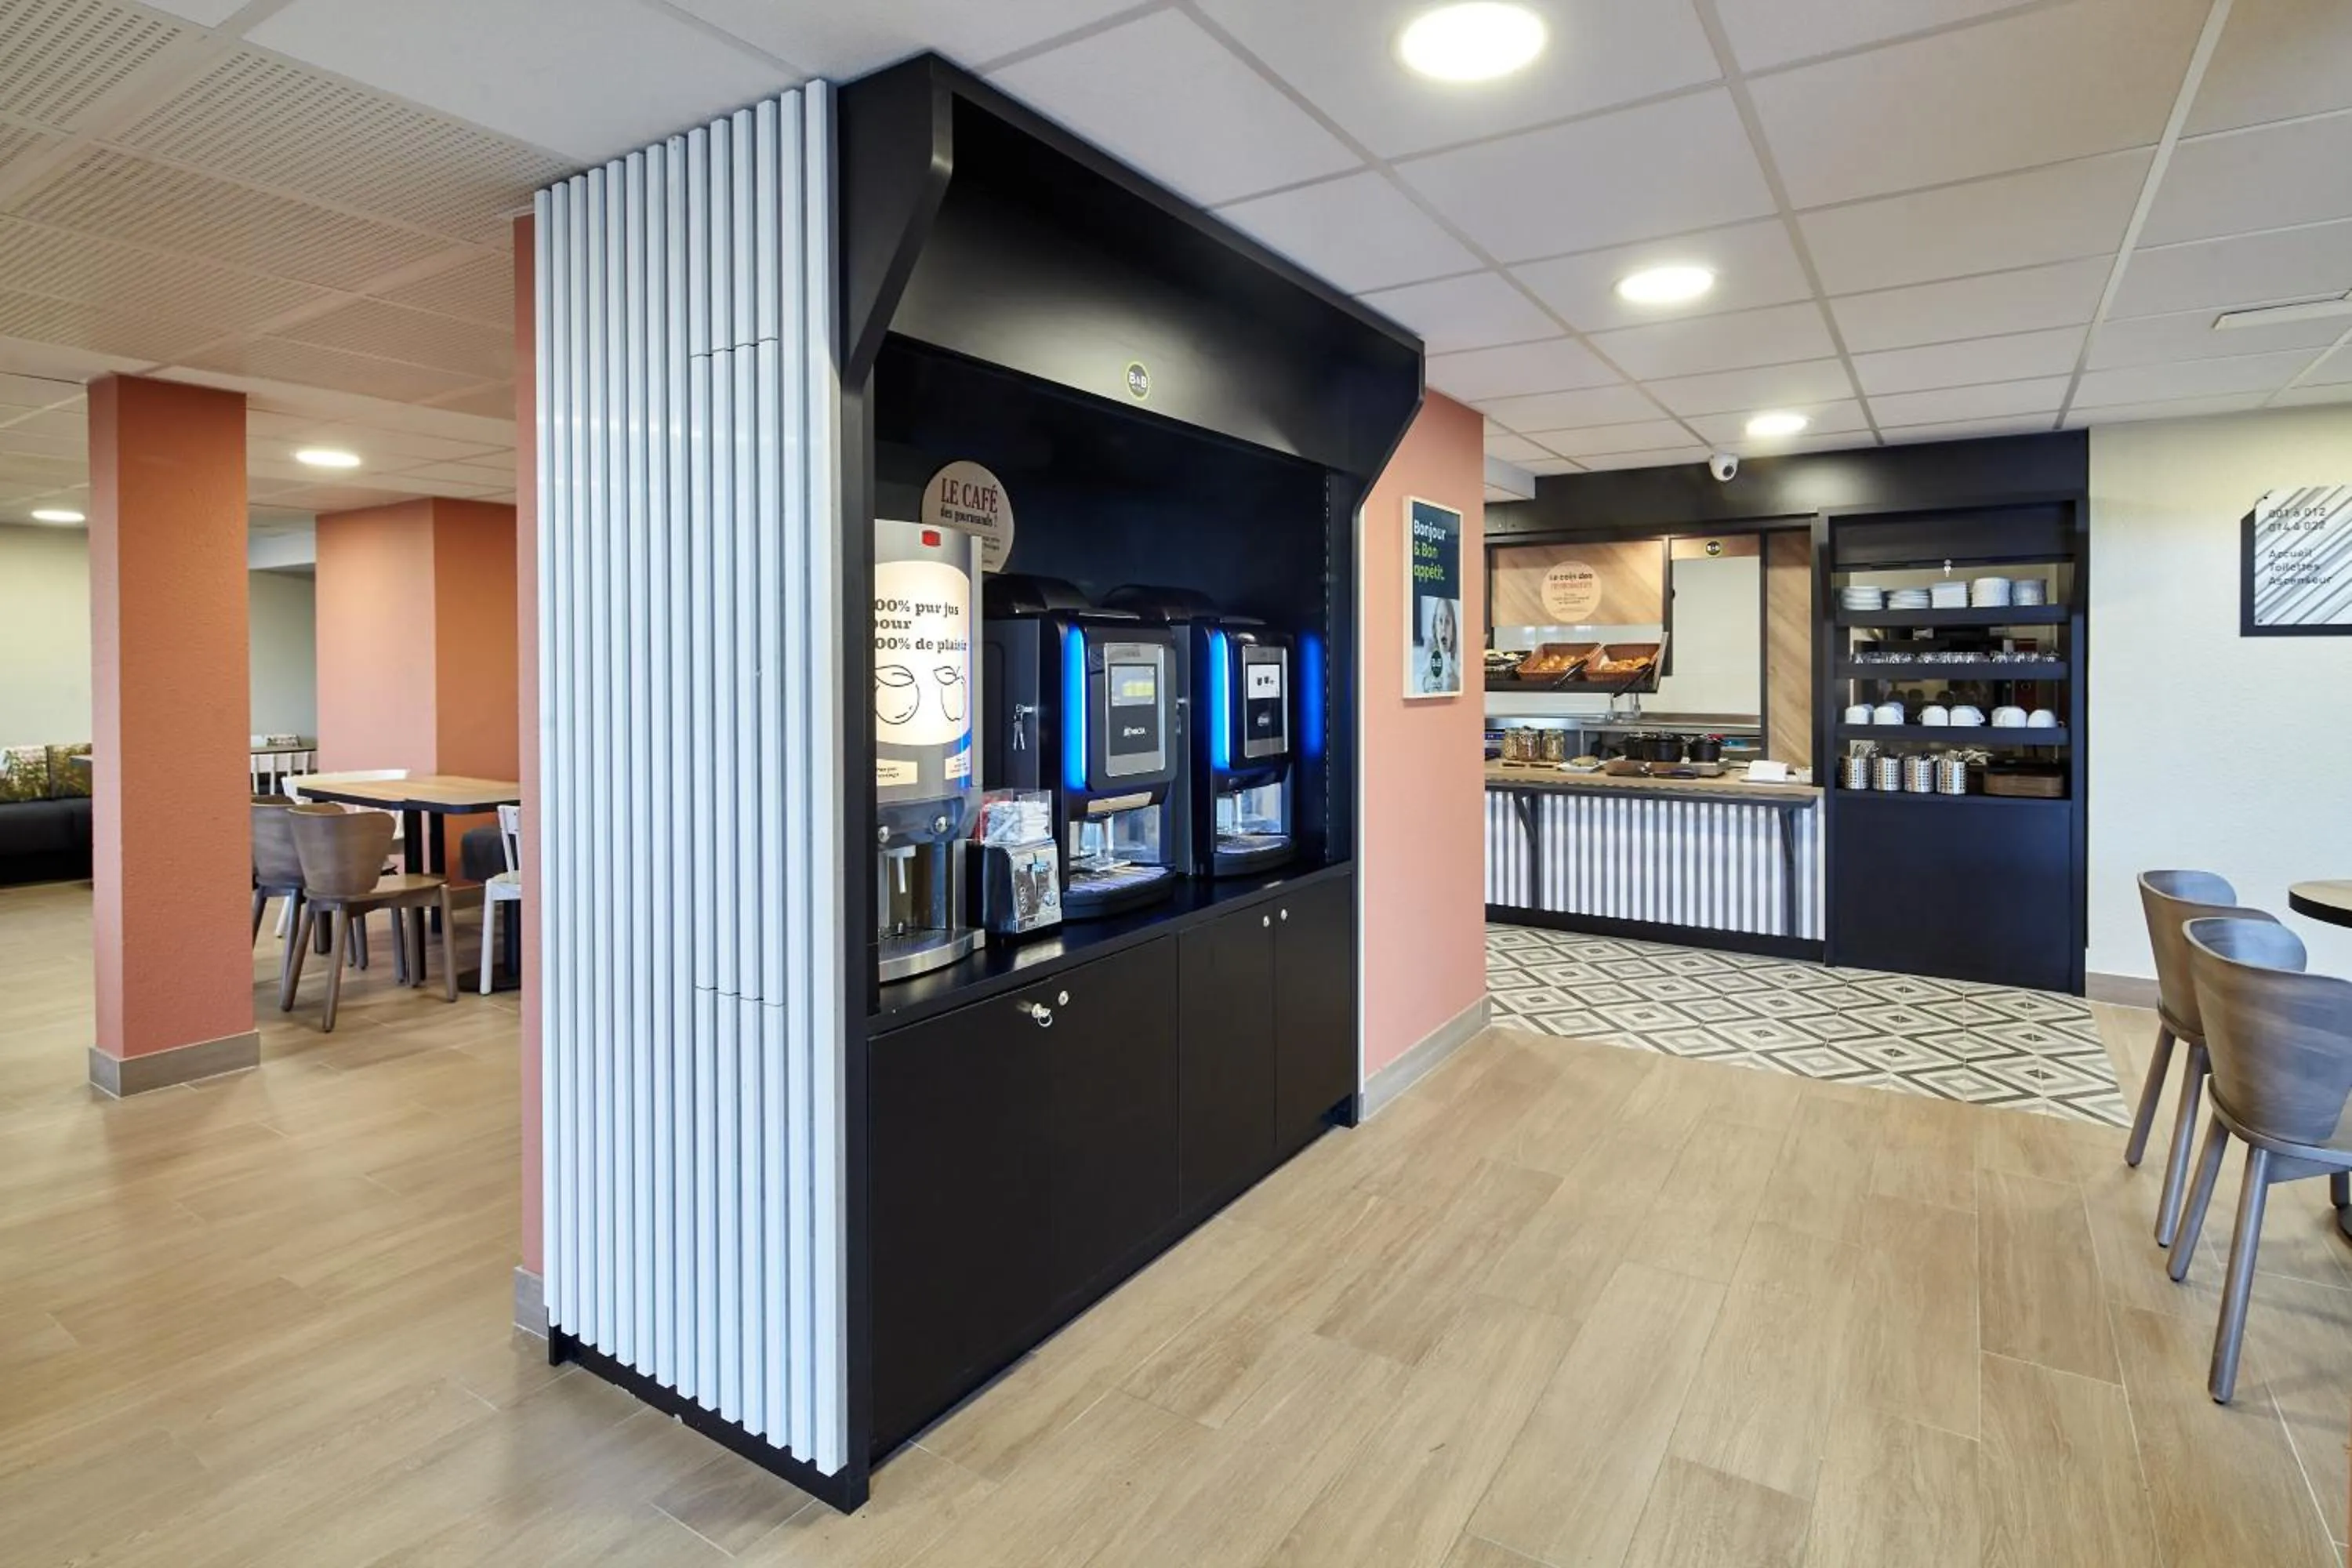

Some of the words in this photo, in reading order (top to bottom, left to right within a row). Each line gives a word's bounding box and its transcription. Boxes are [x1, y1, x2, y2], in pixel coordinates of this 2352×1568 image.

[941, 477, 959, 506] LE
[962, 483, 998, 514] CAFÉ
[1414, 519, 1446, 543] Bonjour
[915, 602, 942, 616] pur
[943, 602, 959, 618] jus
[915, 638, 934, 650] de
